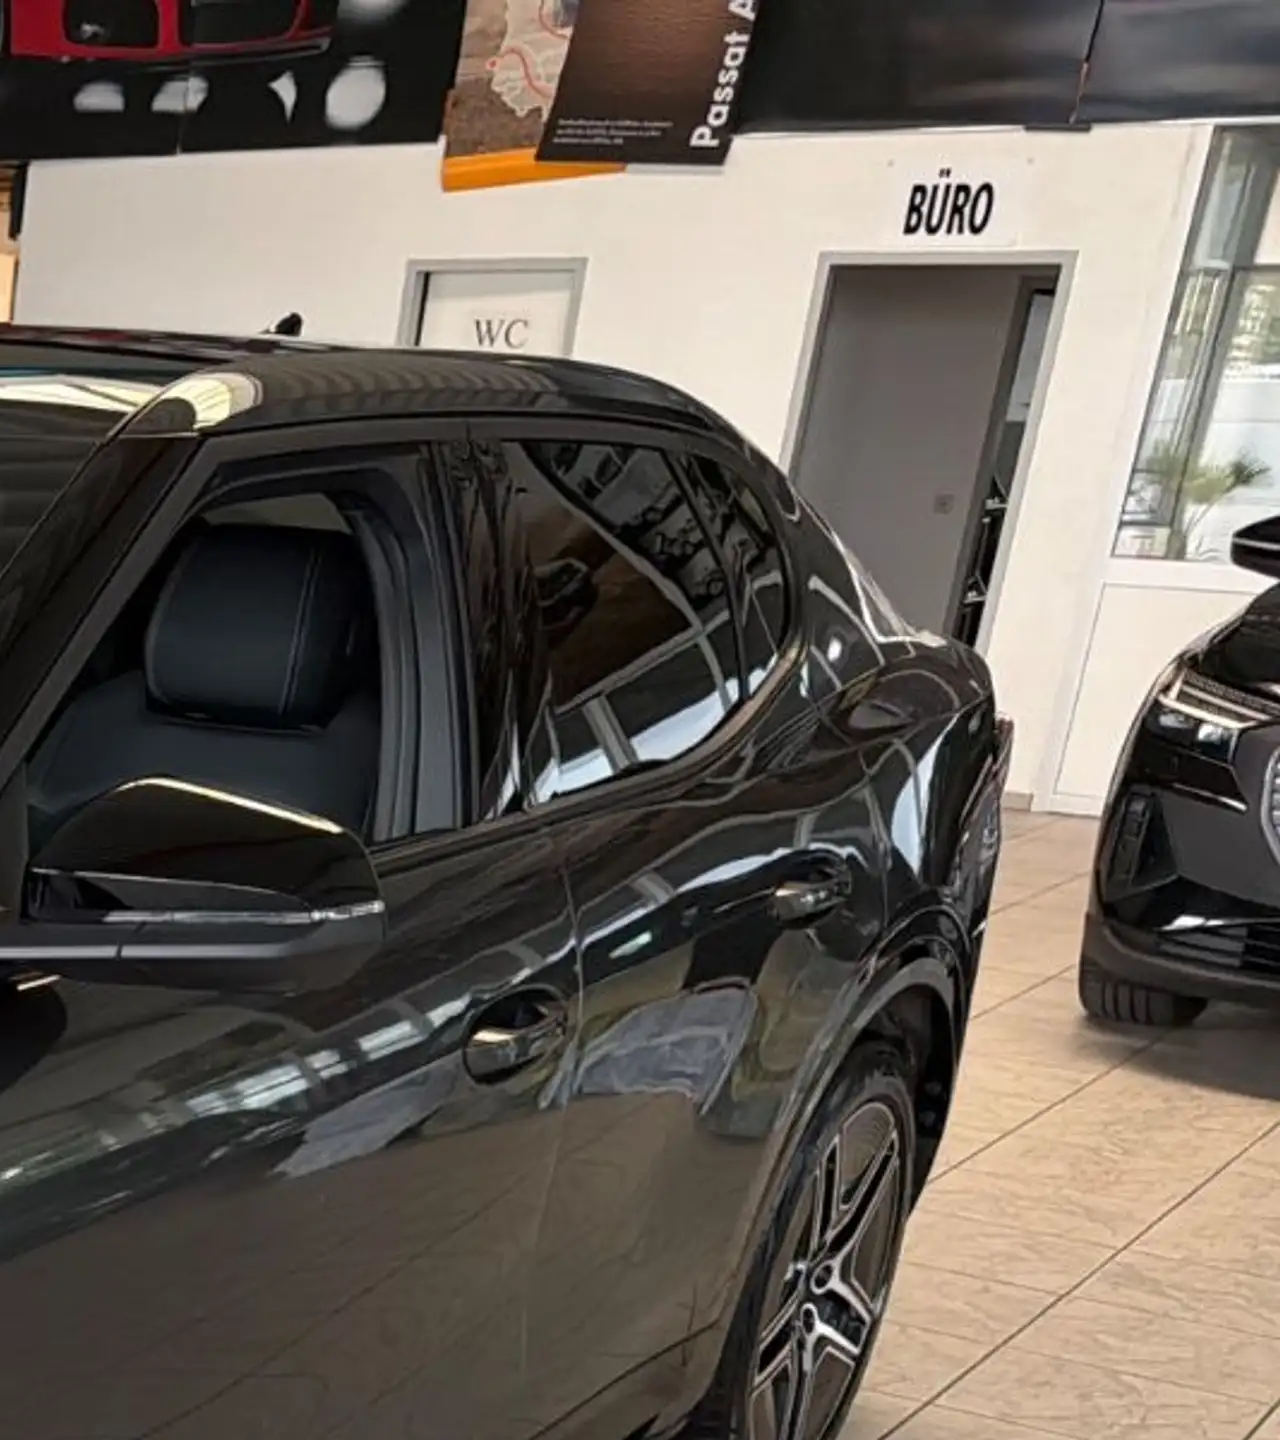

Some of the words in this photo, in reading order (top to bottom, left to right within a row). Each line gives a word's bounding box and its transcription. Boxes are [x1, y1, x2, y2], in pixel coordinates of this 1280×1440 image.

[690, 30, 751, 147] Passat
[903, 167, 994, 236] BÜRO
[474, 318, 530, 349] WC
